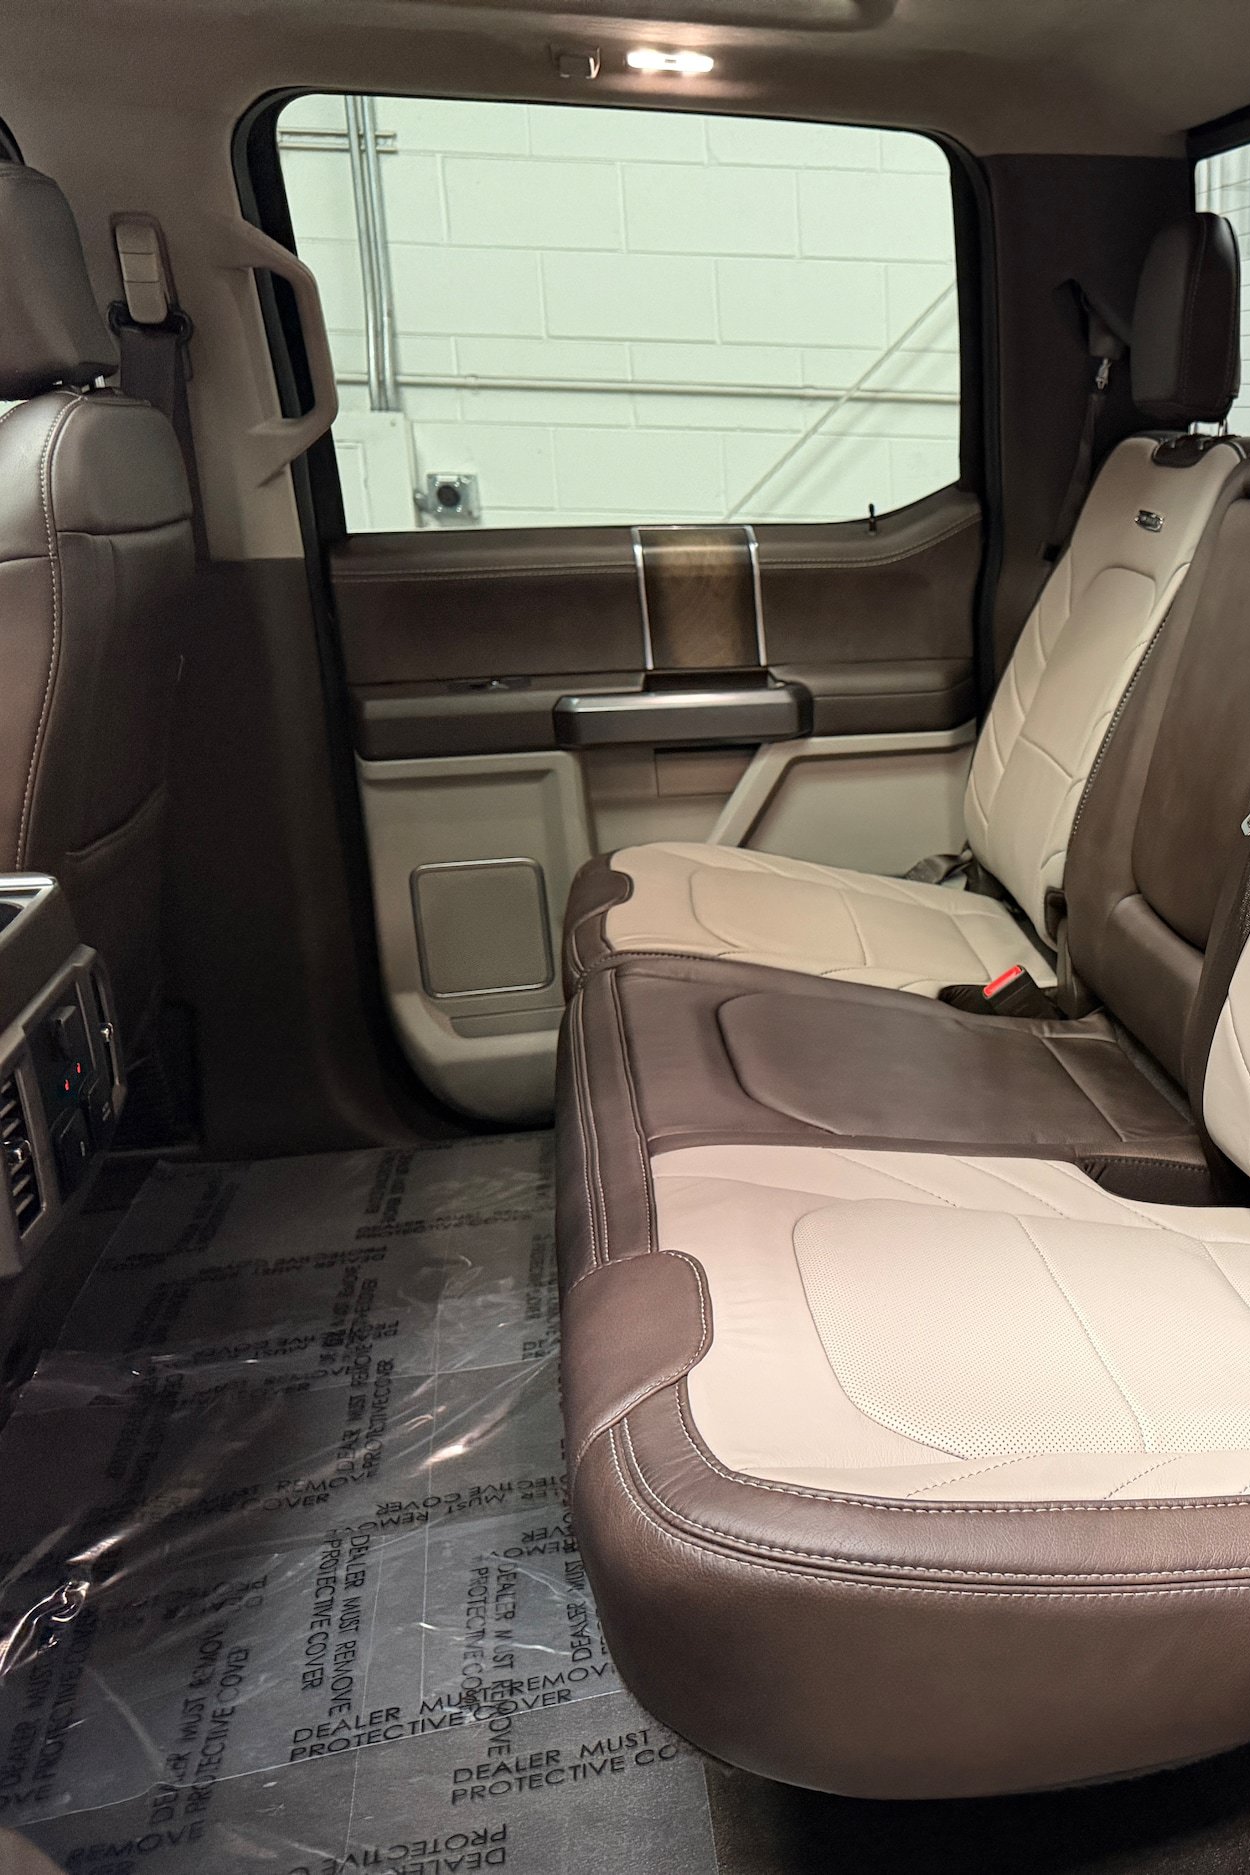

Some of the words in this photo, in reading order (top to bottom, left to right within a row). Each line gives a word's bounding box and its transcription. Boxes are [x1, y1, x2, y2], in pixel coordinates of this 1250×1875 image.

[375, 1492, 461, 1517] COVER
[448, 1493, 504, 1514] MUST
[344, 1533, 371, 1590] DEALER
[521, 1525, 565, 1542] VER
[310, 1538, 343, 1631] PROTECTIVE
[494, 1561, 519, 1622] DEALER
[564, 1558, 586, 1593] MUST
[338, 1596, 363, 1634] MUST
[463, 1566, 490, 1660] PROTECTIVE
[567, 1600, 592, 1663] DEALER
[300, 1631, 329, 1693] COVER
[492, 1628, 515, 1670] MUST
[293, 1706, 401, 1744] DEALER
[419, 1686, 492, 1716] MUST
[507, 1662, 609, 1698] REMOV
[328, 1640, 358, 1718] REMOVE
[174, 1696, 207, 1743] MUST
[290, 1711, 466, 1760] PROTECTIVE
[473, 1688, 573, 1722] COVER
[184, 1705, 235, 1814] PROTECTIVE
[451, 1756, 625, 1806] PROTECTIVE
[452, 1750, 560, 1785] DEALER
[579, 1730, 649, 1760] MUST
[323, 1823, 508, 1875] PROTECTIVE
